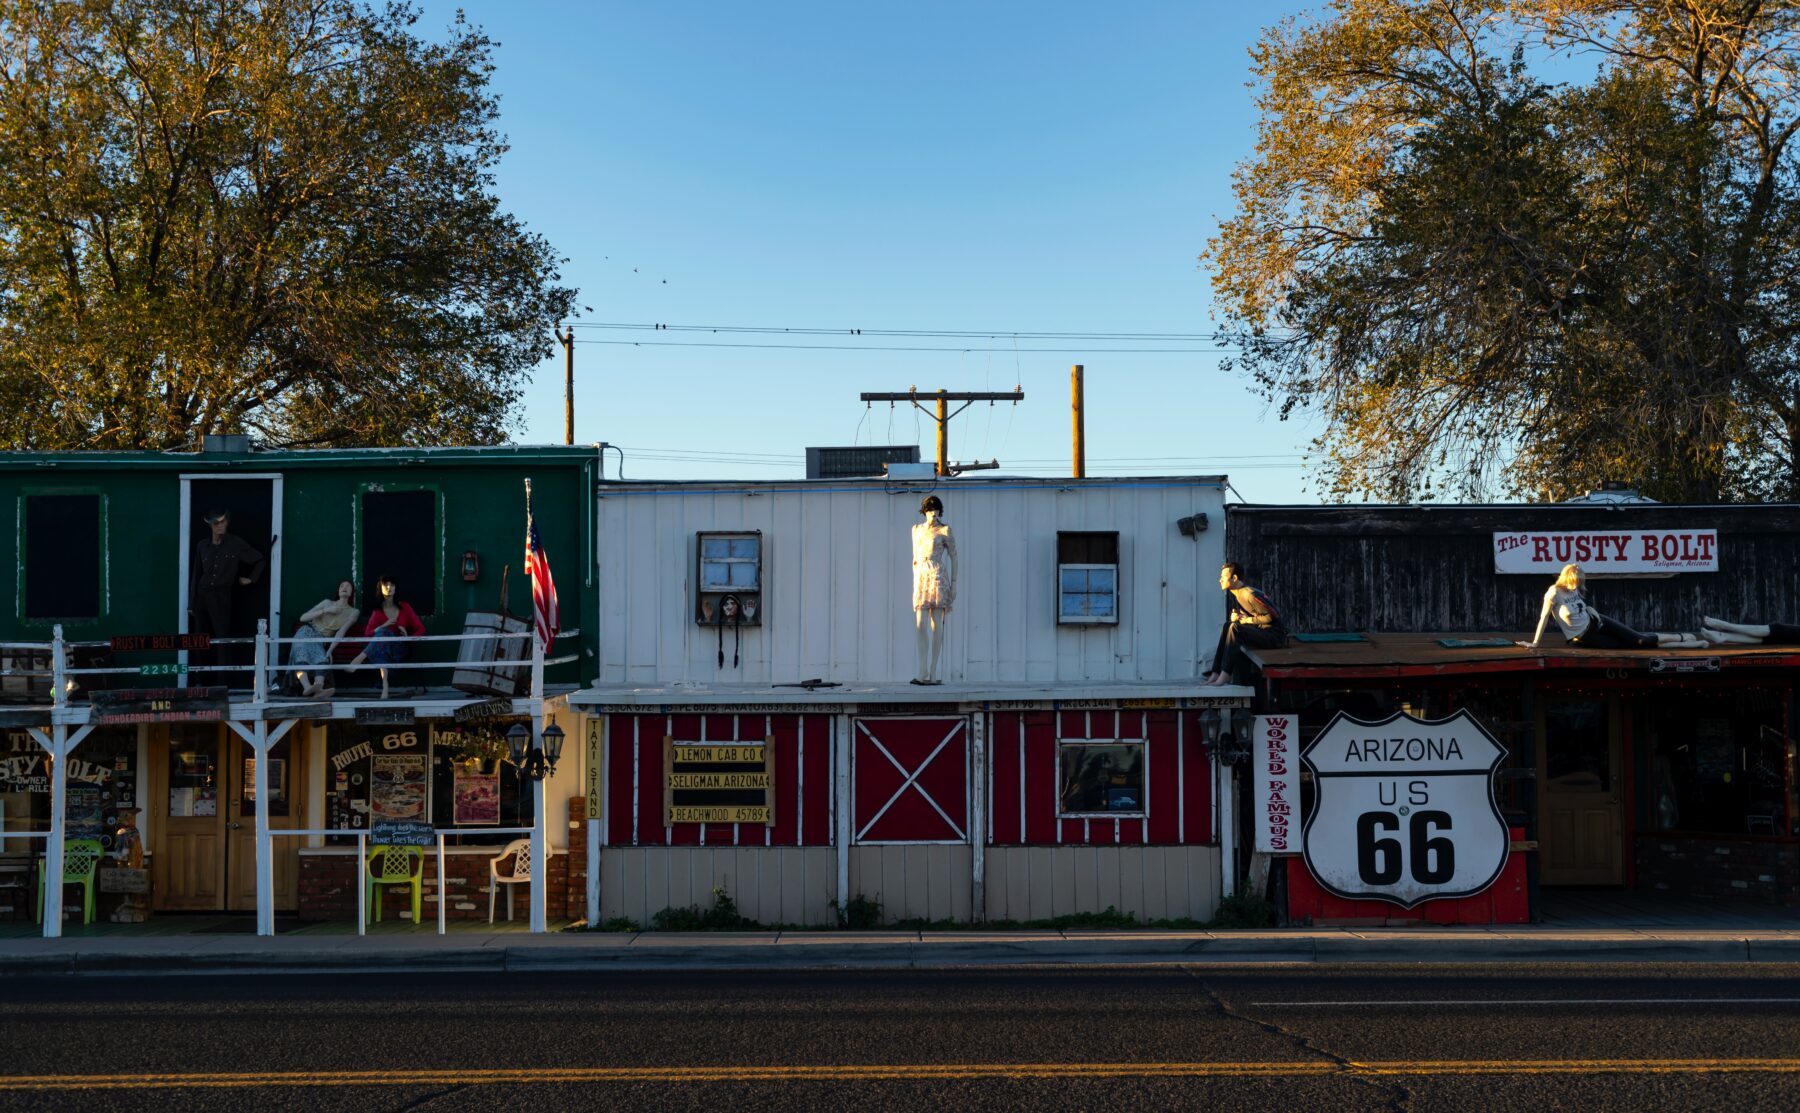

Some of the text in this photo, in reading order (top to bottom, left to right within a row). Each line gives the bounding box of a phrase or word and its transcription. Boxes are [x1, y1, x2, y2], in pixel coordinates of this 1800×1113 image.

[1497, 534, 1715, 562] The RUSTY BOLT
[1686, 559, 1710, 567] Arizona
[115, 635, 205, 650] RUSTY BOLT BLVD
[142, 664, 188, 675] 22345
[151, 700, 171, 711] AND
[160, 711, 191, 722] INDIAN
[331, 740, 374, 771] ROUTE
[382, 731, 418, 750] 66
[682, 748, 756, 761] LEMON CAB CO
[1344, 738, 1463, 762] ARIZONA
[66, 759, 112, 786] OLT
[590, 721, 598, 817] TAXI STAND
[17, 776, 47, 785] OWNER
[723, 775, 765, 788] ARIZONA
[1265, 717, 1291, 850] WORLD FAMOUS
[676, 808, 763, 821] BEACHWOOD 45789
[1356, 810, 1455, 885] 66
